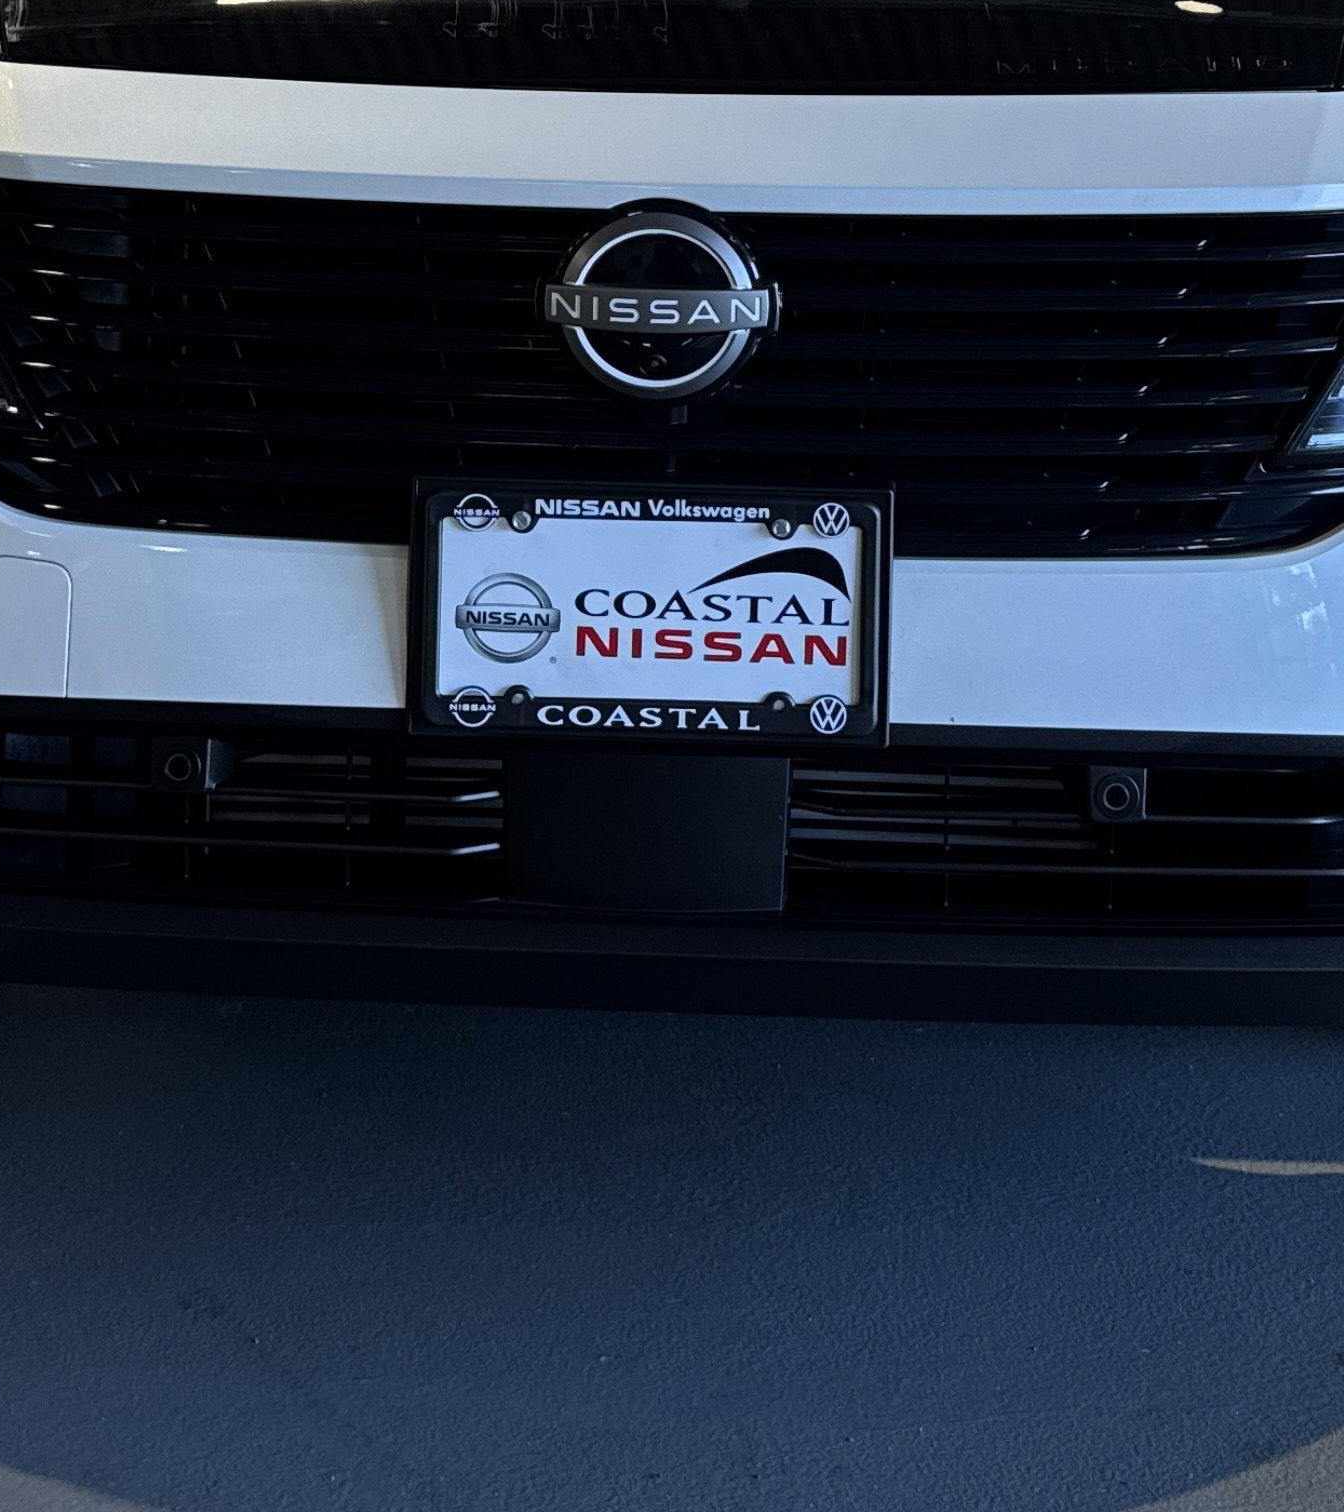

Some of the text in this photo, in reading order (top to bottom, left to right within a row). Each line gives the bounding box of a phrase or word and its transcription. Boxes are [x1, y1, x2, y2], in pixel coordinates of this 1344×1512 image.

[996, 55, 1292, 74] MURANO
[551, 292, 761, 325] NISSAN
[453, 508, 500, 517] NISSAN
[535, 498, 770, 522] NISSAN Volkswagen
[465, 609, 550, 627] NISSAN
[574, 588, 850, 627] COASTAL
[575, 626, 847, 667] NISSAN
[449, 703, 496, 712] NISSAN
[537, 705, 761, 731] COASTAL
